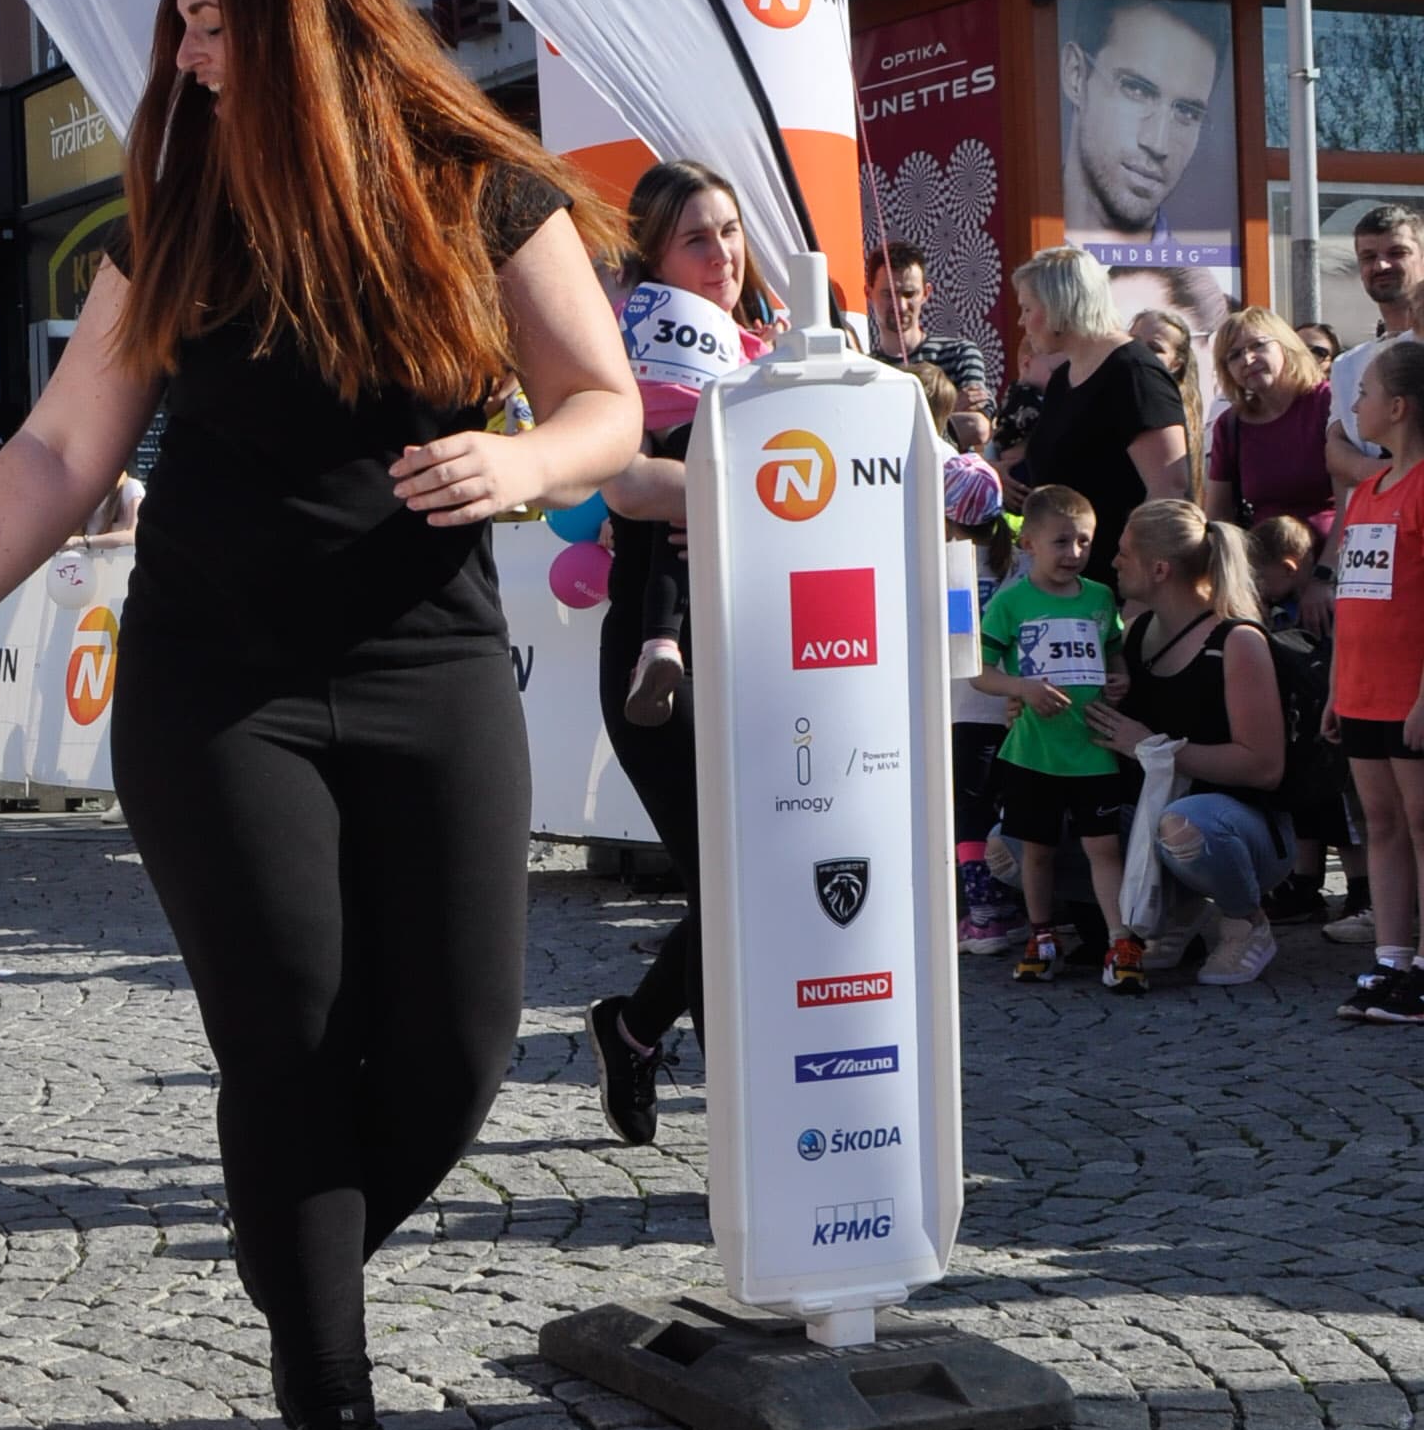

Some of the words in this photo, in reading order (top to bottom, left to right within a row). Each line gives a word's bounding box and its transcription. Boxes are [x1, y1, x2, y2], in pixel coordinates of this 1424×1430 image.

[880, 42, 947, 70] OPTIKA
[859, 65, 996, 122] UNETTES
[1099, 248, 1200, 263] INDBERG
[628, 304, 647, 313] CUP
[851, 457, 903, 487] NN
[1345, 549, 1389, 569] 3042
[801, 639, 868, 662] AVON
[1049, 641, 1097, 659] 3156
[775, 796, 834, 814] innogy
[802, 979, 889, 1002] NUTREND
[830, 1126, 902, 1154] ŠKODA
[812, 1214, 891, 1247] KPMG
